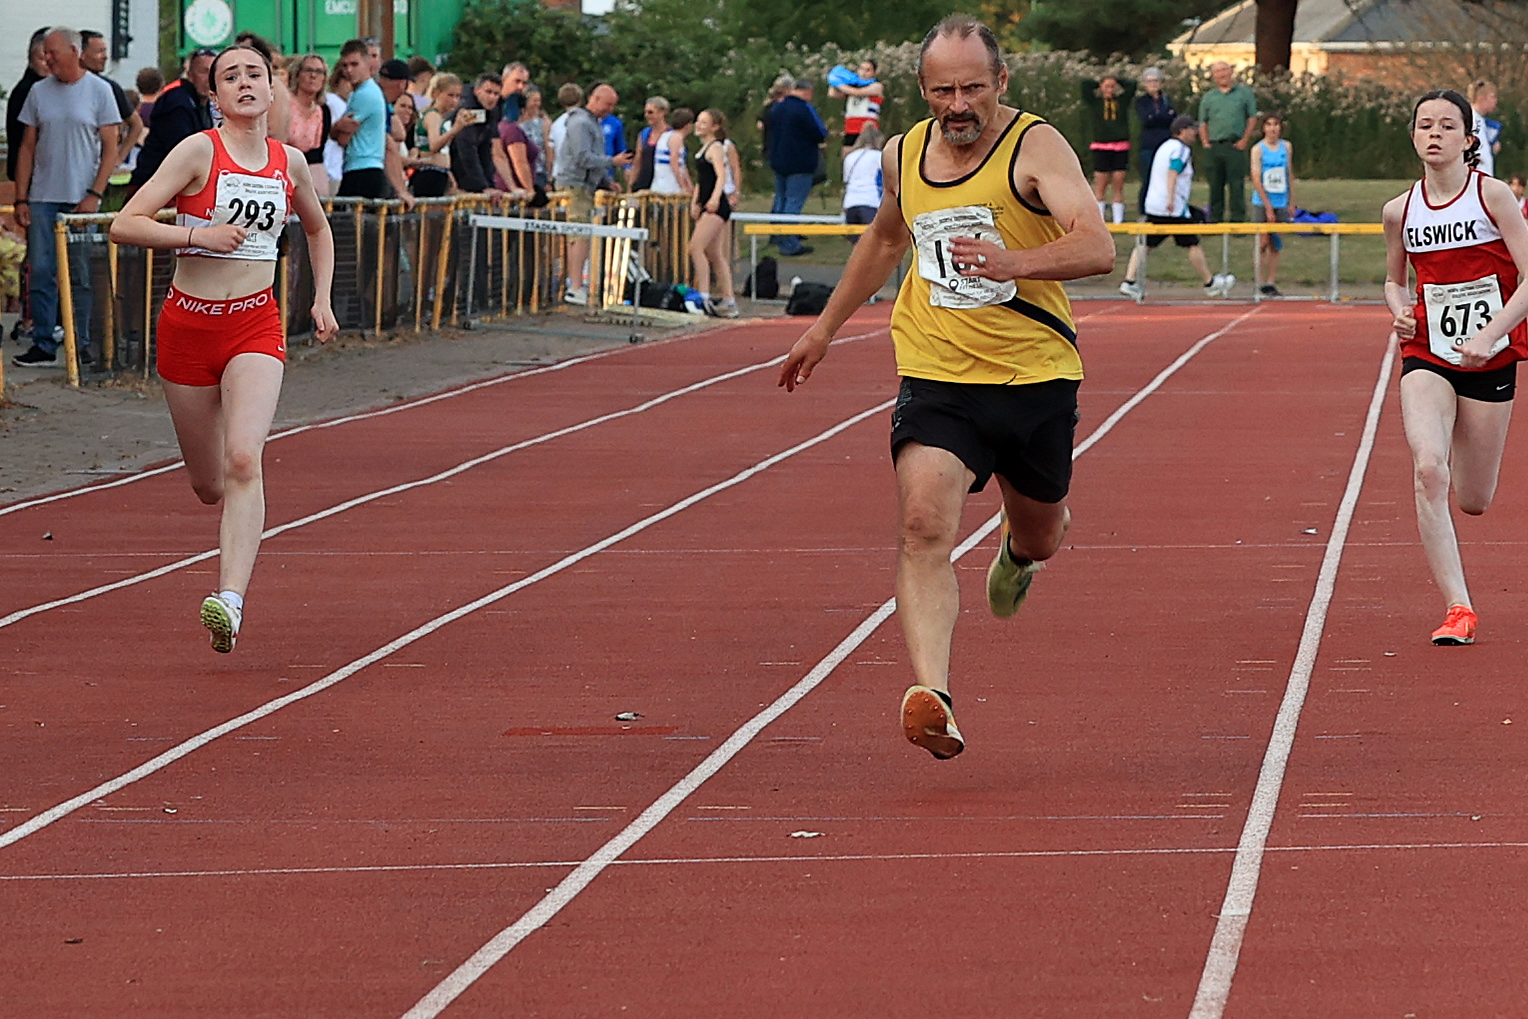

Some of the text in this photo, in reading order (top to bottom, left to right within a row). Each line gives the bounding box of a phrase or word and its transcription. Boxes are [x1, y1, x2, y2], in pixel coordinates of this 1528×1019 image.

[226, 198, 276, 231] 293
[1407, 220, 1478, 248] ELSWICK
[176, 293, 268, 315] NIKE PRO
[1440, 300, 1492, 338] 673
